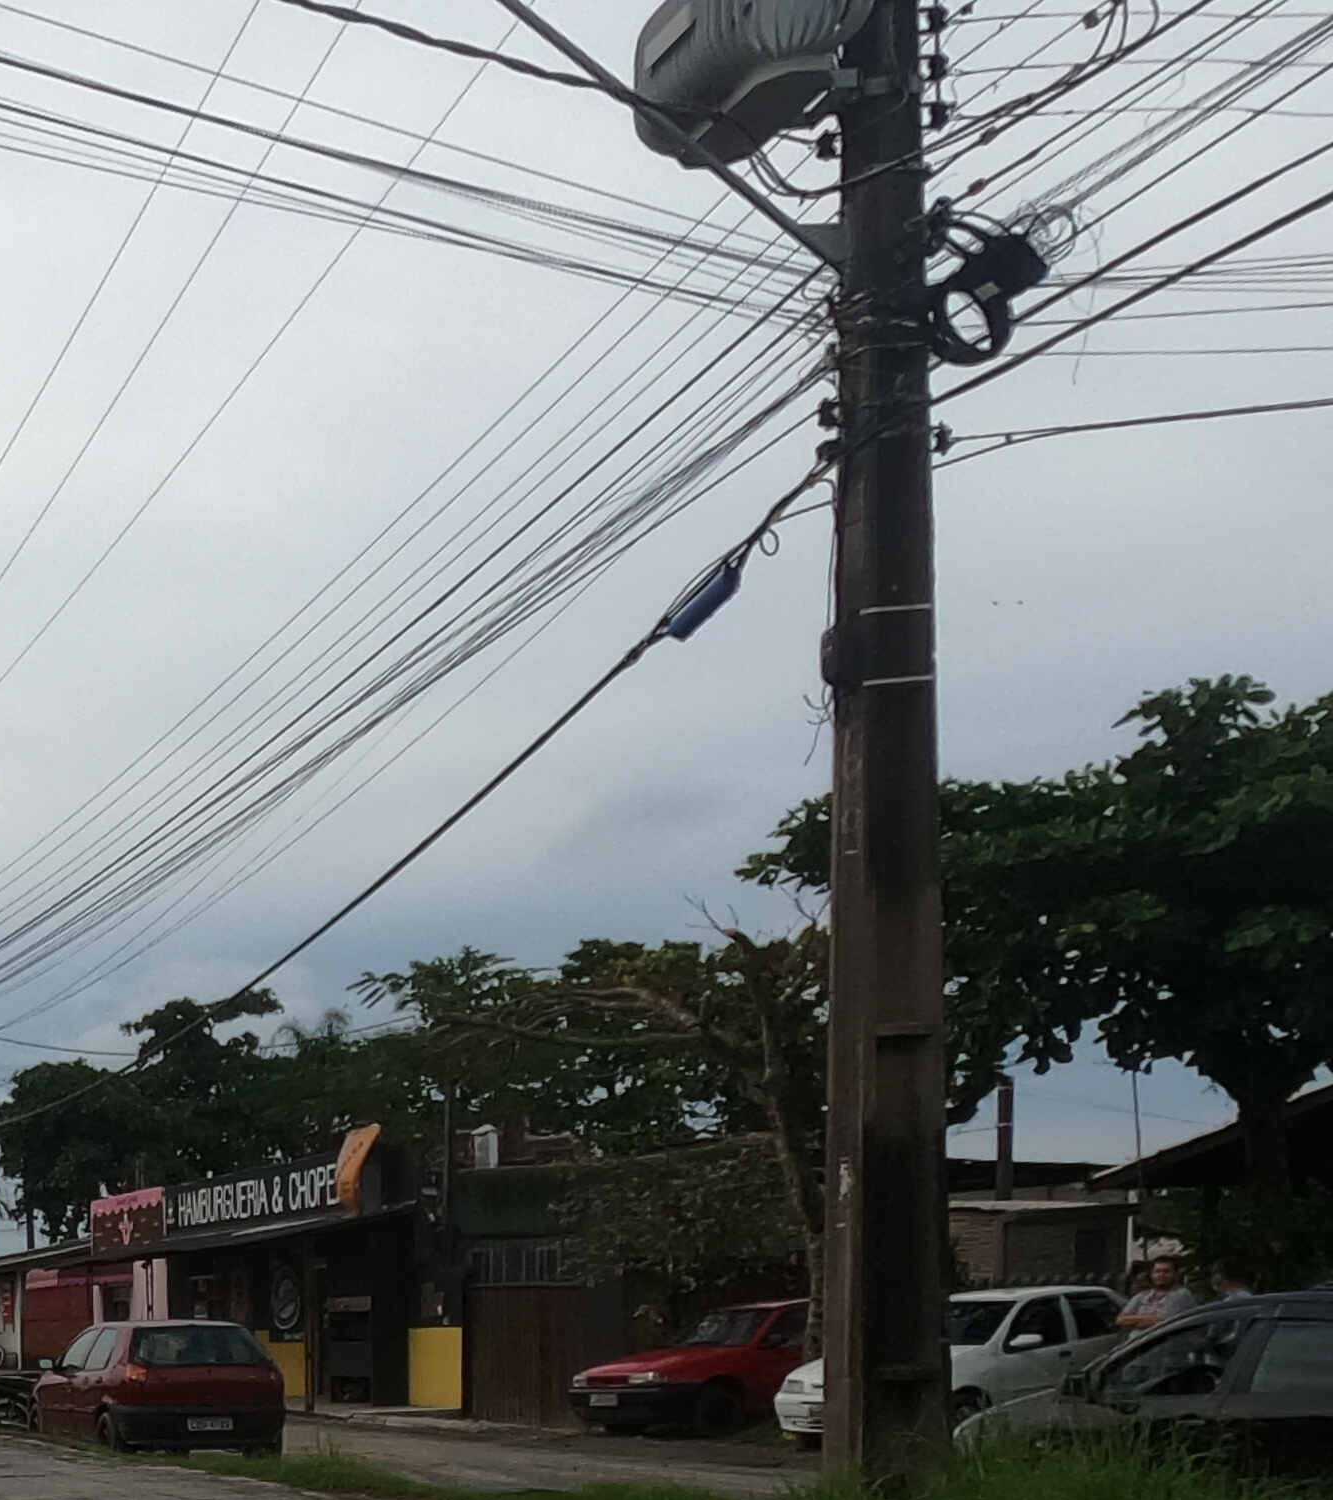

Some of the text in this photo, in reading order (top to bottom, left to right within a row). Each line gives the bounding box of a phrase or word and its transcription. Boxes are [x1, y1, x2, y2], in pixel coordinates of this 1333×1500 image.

[177, 1163, 340, 1227] HAMBURGUERIA & CHOPE
